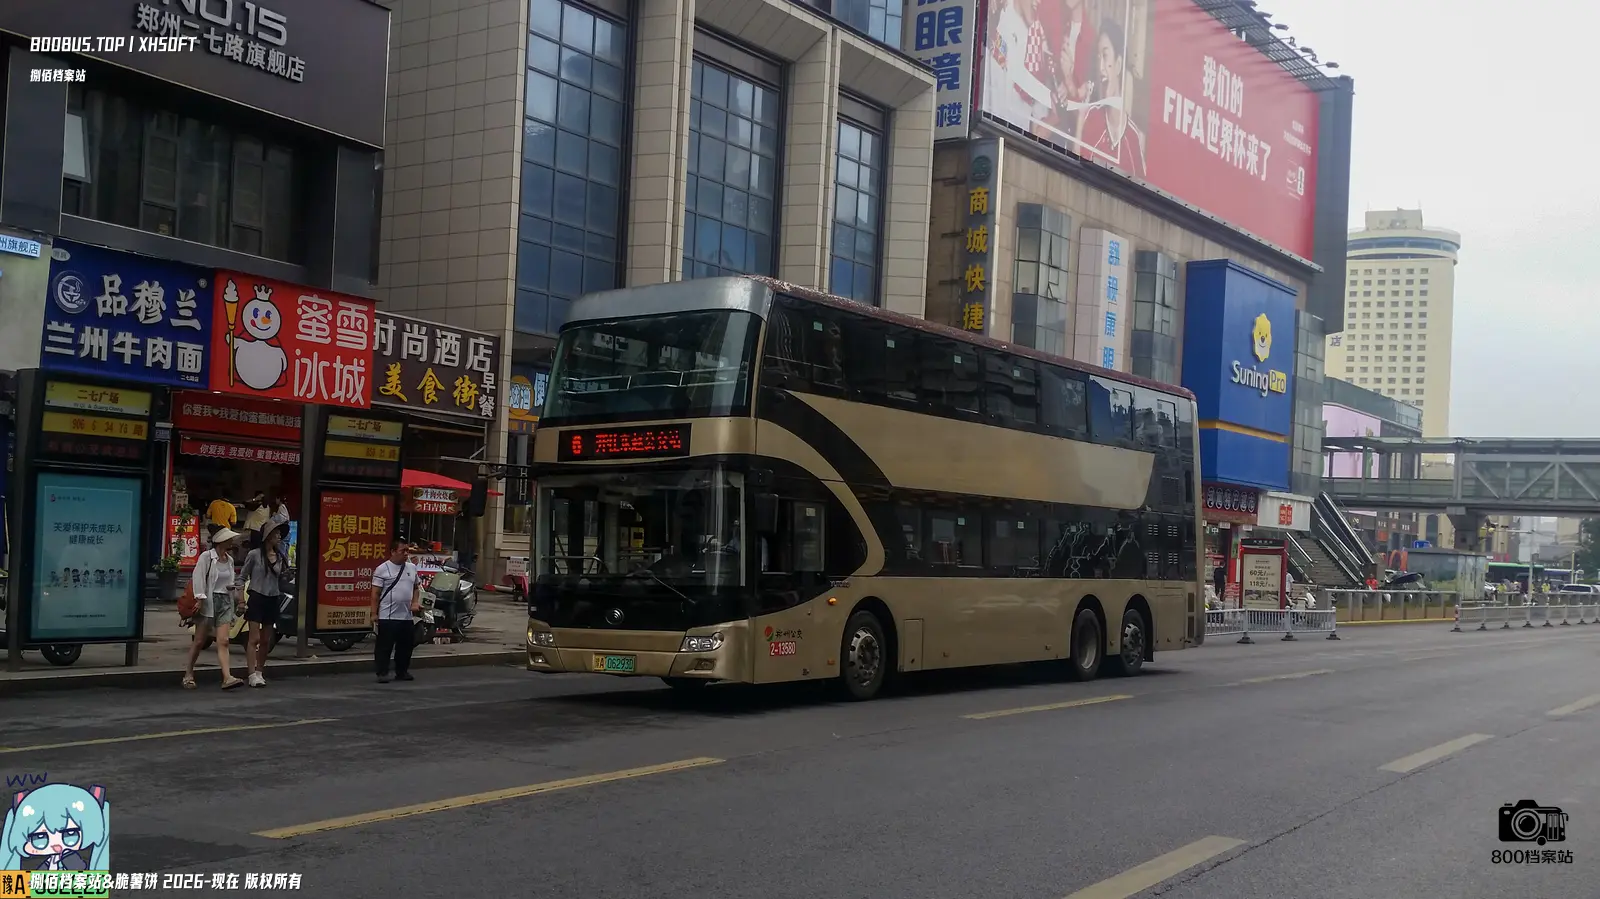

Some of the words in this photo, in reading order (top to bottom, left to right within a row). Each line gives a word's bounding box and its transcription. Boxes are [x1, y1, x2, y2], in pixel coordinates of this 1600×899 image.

[136, 3, 306, 82] 郑州二七路旗舰店
[915, 0, 963, 128] 眼镜楼
[1202, 55, 1244, 118] 我们的
[1163, 86, 1271, 181] FIFA世界杯来了
[963, 186, 990, 330] 商城快捷
[95, 274, 202, 331] 品穆兰
[295, 293, 369, 351] 蜜雪
[44, 320, 204, 374] 兰州牛肉面
[372, 318, 494, 373] 时尚酒店
[77, 389, 120, 404] 二七广场
[293, 348, 366, 406] 冰城
[379, 362, 480, 411] 美食街
[478, 372, 496, 418] 早餐
[182, 402, 212, 418] 你爱我
[348, 418, 382, 432] 二七广场
[200, 444, 226, 456] 你爱我
[228, 446, 254, 458] 我爱你
[53, 522, 124, 534] 关爱保护未成年人
[68, 534, 104, 546] 健康成长
[327, 514, 387, 536] 植得口腔
[322, 536, 386, 563] 15周年庆
[357, 567, 372, 577] 1480
[356, 581, 372, 590] 4980
[770, 642, 796, 656] 2-13580
